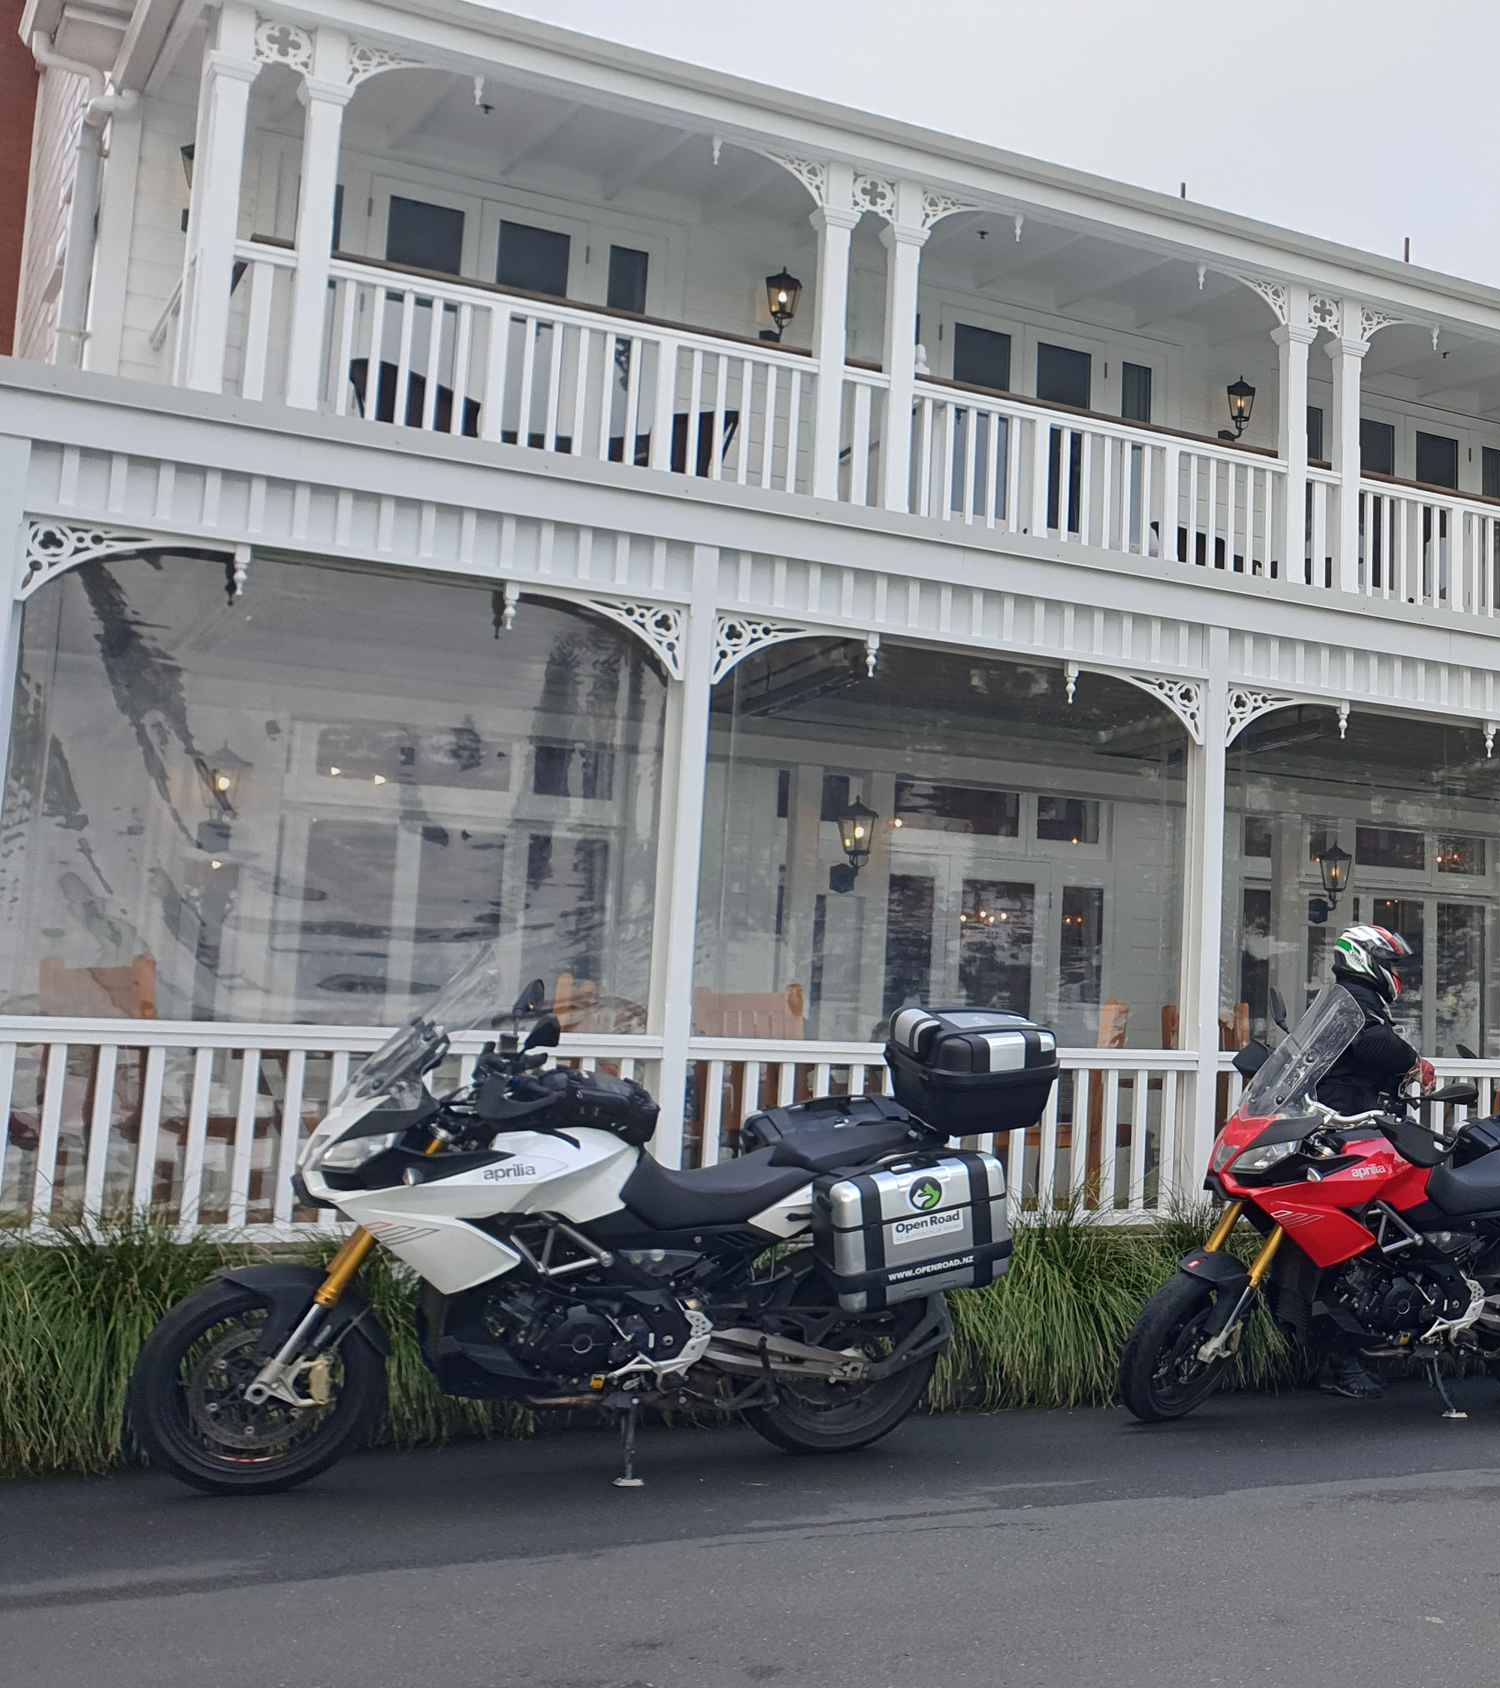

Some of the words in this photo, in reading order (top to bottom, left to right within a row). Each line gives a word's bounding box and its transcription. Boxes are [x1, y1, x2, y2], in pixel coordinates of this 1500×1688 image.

[483, 1163, 536, 1181] aprilia
[1351, 1164, 1386, 1180] aprilia
[895, 1220, 929, 1234] Open
[930, 1210, 960, 1227] Road
[888, 1255, 974, 1281] WWW.OPENROAD.NZ
